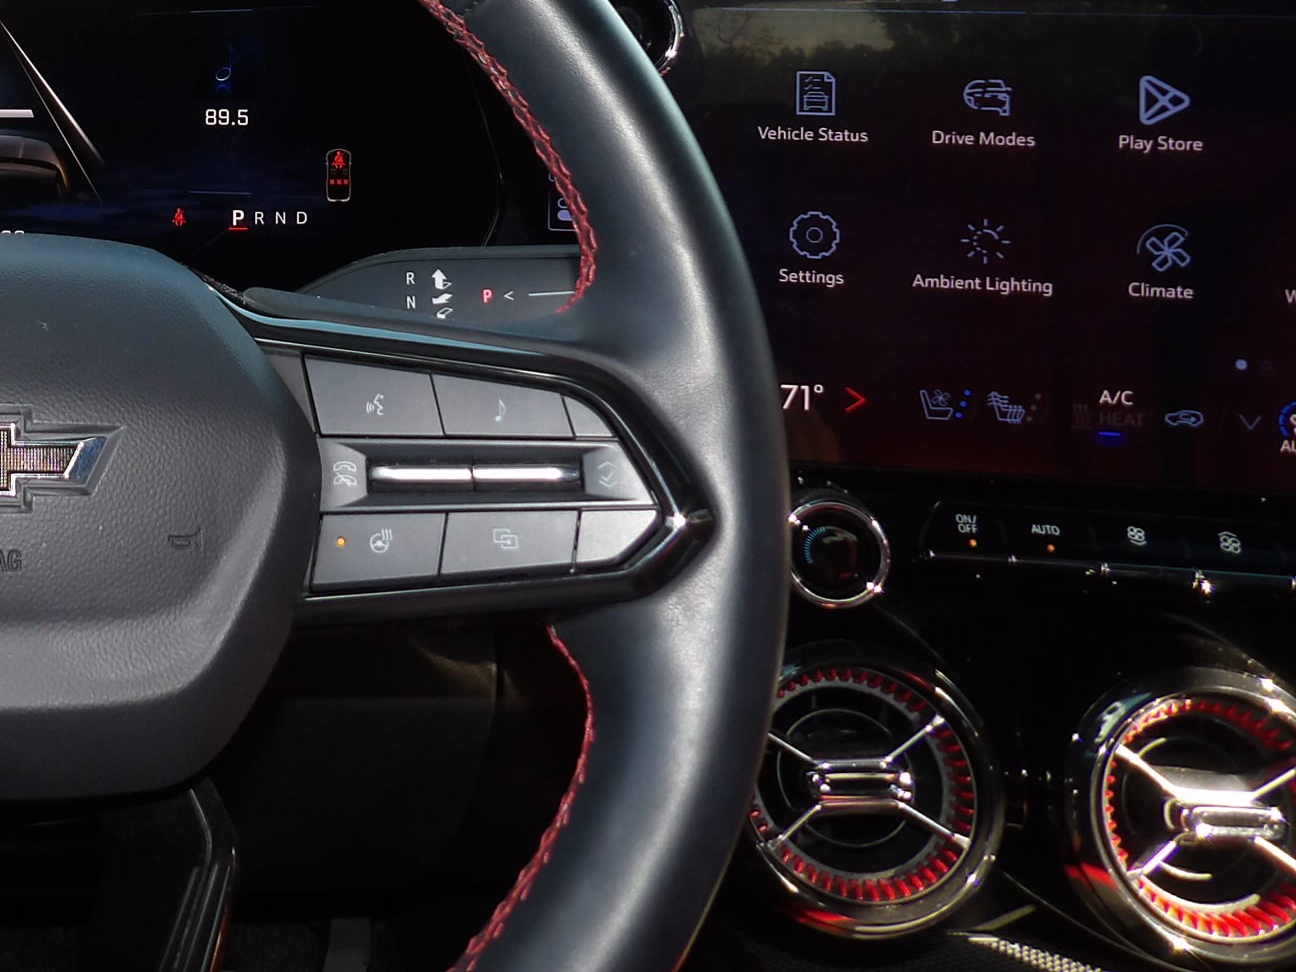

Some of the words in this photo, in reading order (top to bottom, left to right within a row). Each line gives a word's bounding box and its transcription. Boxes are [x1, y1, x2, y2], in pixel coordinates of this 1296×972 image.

[205, 108, 249, 126] 89.5
[758, 126, 814, 142] Vehicle
[818, 128, 868, 143] Status
[931, 131, 975, 146] Drive
[979, 132, 1036, 147] Modes
[1118, 135, 1153, 153] Play
[1157, 137, 1203, 152] Store
[232, 210, 245, 226] P
[255, 211, 265, 225] R
[275, 211, 286, 225] N
[296, 211, 308, 225] D
[406, 272, 415, 284] R
[779, 268, 844, 287] Settings
[912, 274, 982, 290] Ambient
[987, 276, 1053, 296] Lighting
[483, 289, 493, 303] P
[1128, 283, 1194, 299] Climate
[406, 296, 416, 309] N
[1099, 389, 1134, 406] A/C
[957, 523, 978, 533] OFF
[1031, 524, 1061, 536] AUTO
